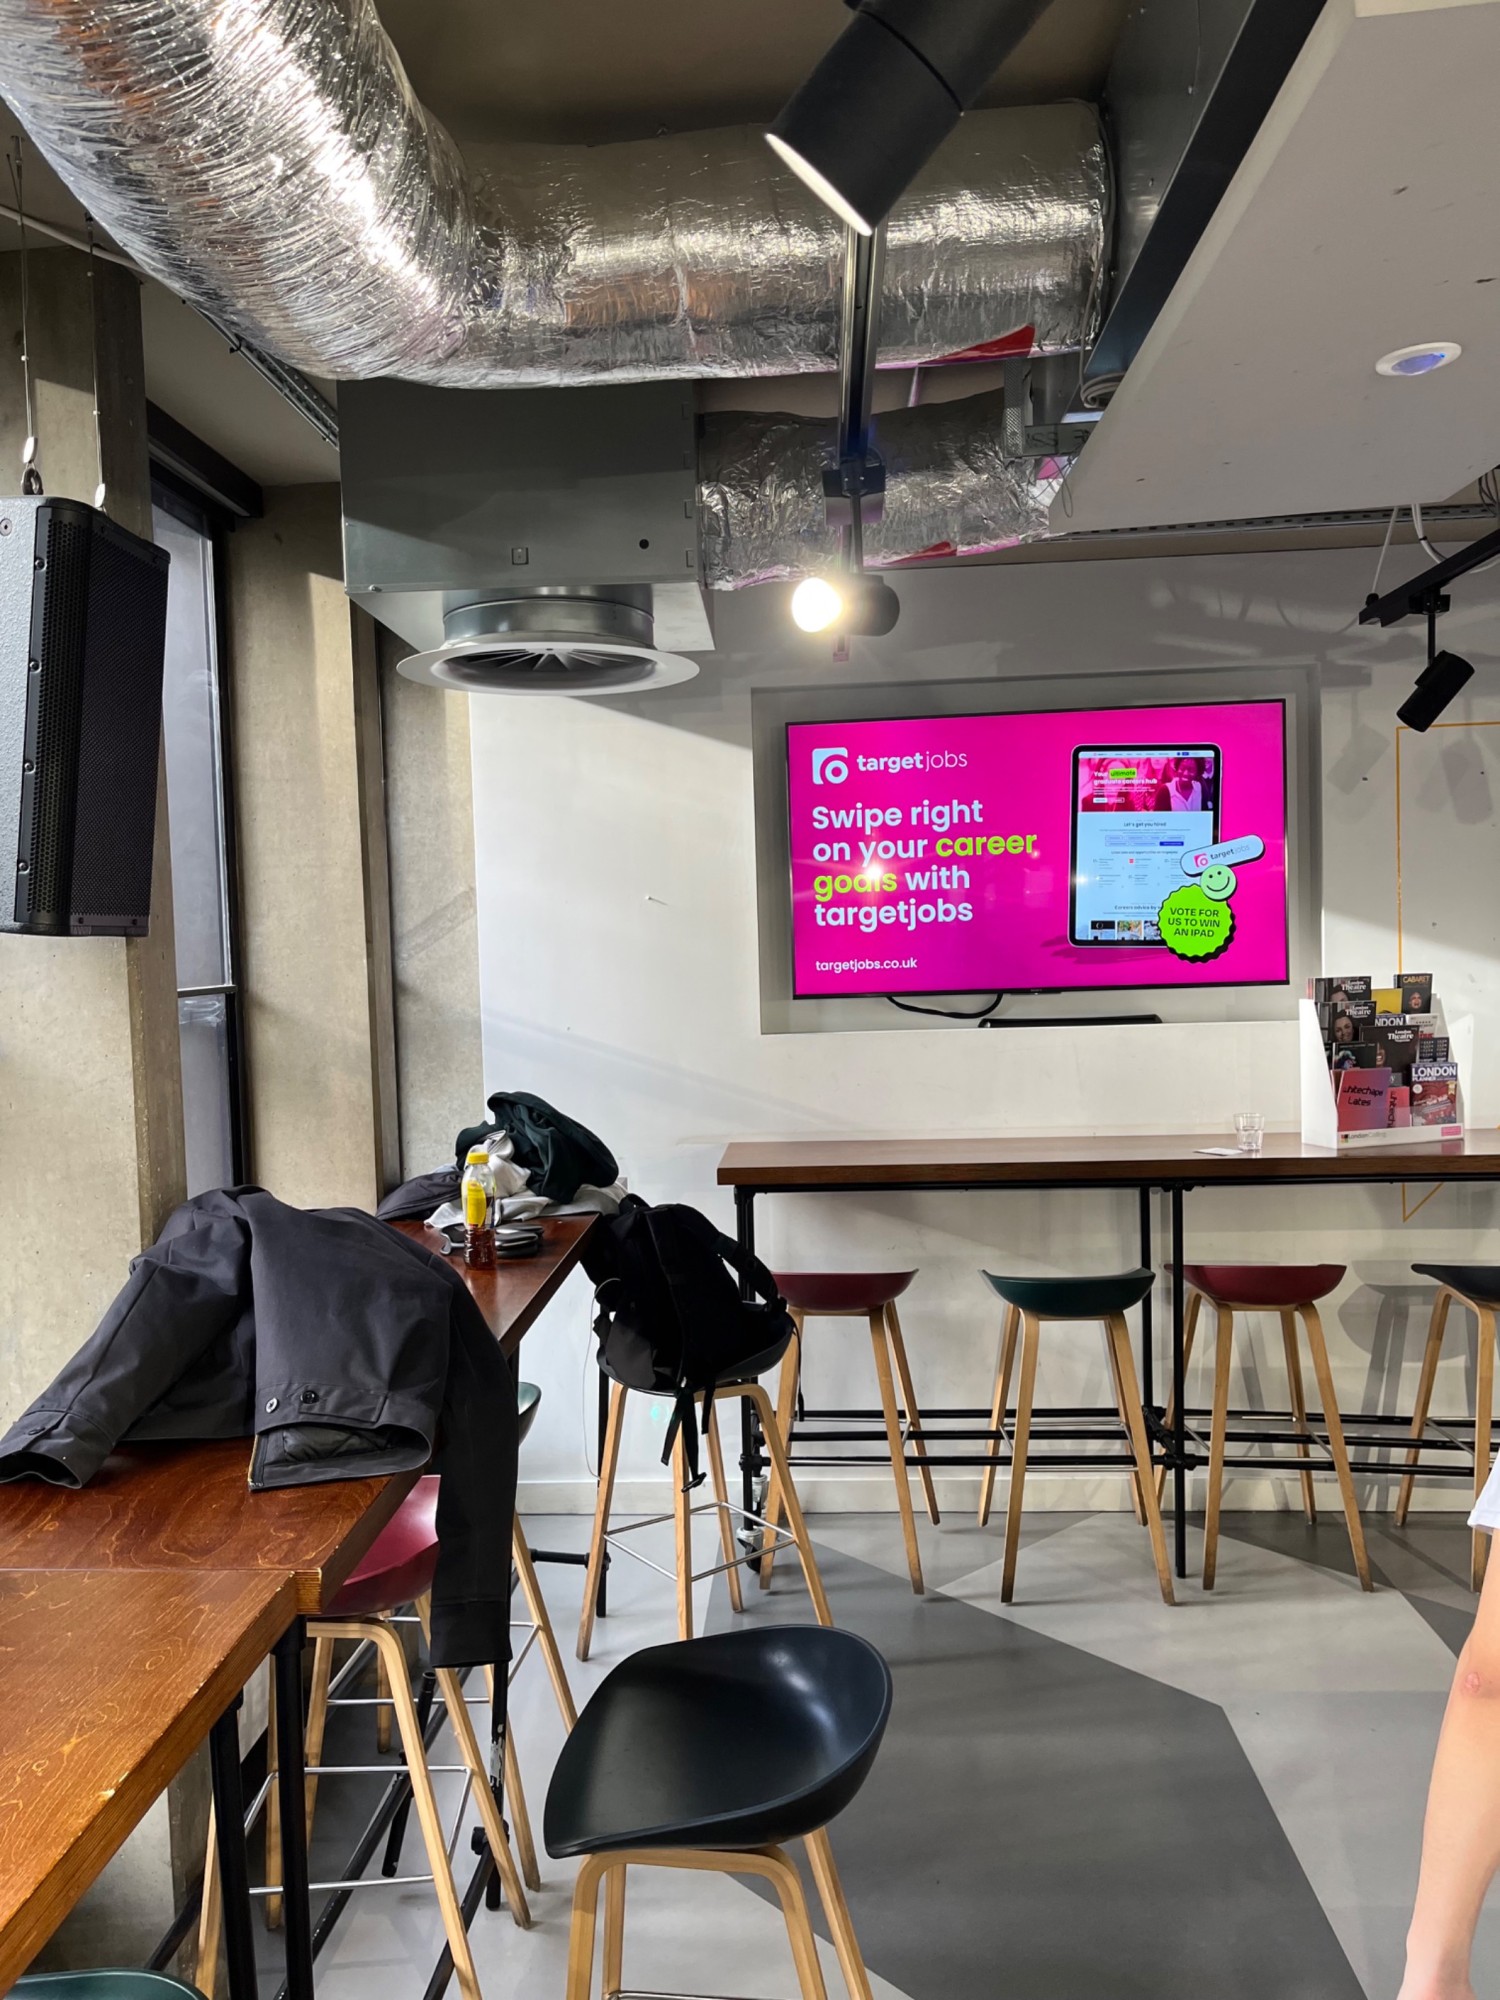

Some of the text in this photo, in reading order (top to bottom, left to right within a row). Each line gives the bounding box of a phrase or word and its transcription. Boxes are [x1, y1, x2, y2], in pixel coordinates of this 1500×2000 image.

[857, 751, 968, 773] targetjobs
[812, 800, 983, 834] Swipe right
[812, 834, 1037, 867] on your career
[905, 865, 970, 890] with
[814, 898, 973, 933] targetjobs
[1170, 907, 1196, 916] VOTE
[1199, 909, 1219, 917] FOR
[1168, 918, 1220, 927] US TO WIN
[1174, 928, 1214, 937] AN IPAD
[815, 957, 917, 974] targetjobs.co.uk
[1403, 975, 1430, 983] CABARET
[1375, 1017, 1404, 1027] NDON
[1412, 1066, 1456, 1077] LONDON
